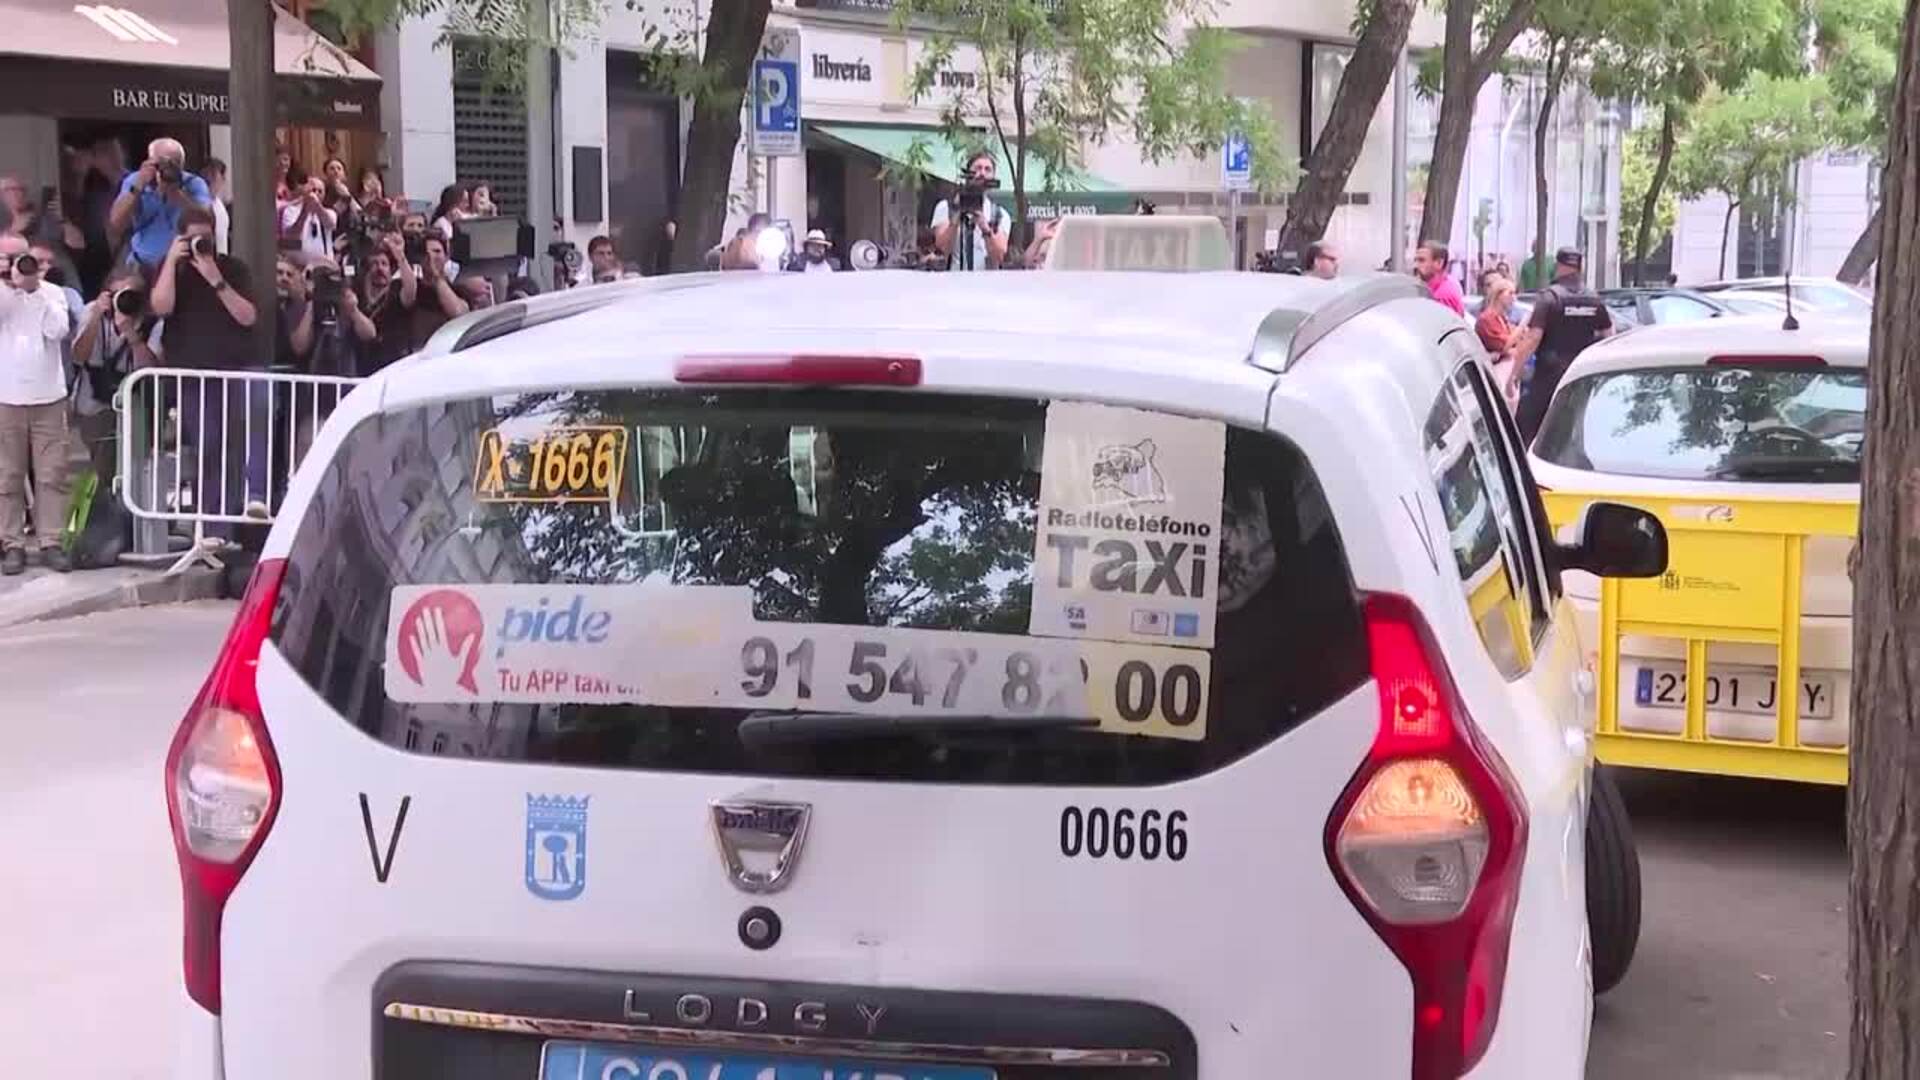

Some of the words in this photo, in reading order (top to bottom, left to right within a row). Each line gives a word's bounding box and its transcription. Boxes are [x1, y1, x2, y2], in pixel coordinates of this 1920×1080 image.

[812, 53, 872, 82] librería
[113, 88, 151, 109] BAR
[154, 90, 176, 110] EL
[1109, 231, 1188, 268] TAXI
[528, 432, 617, 492] 1666
[1047, 508, 1212, 538] Radioteléfono
[1046, 533, 1207, 599] Taxi
[496, 594, 612, 659] pide
[498, 668, 520, 692] Tu
[525, 668, 569, 693] APP
[740, 636, 816, 698] 91
[845, 641, 979, 710] 547
[1115, 659, 1202, 727] 00
[1757, 678, 1823, 713] JY
[359, 791, 412, 884] V
[1060, 805, 1189, 862] 00666
[623, 988, 888, 1034] LODGY
